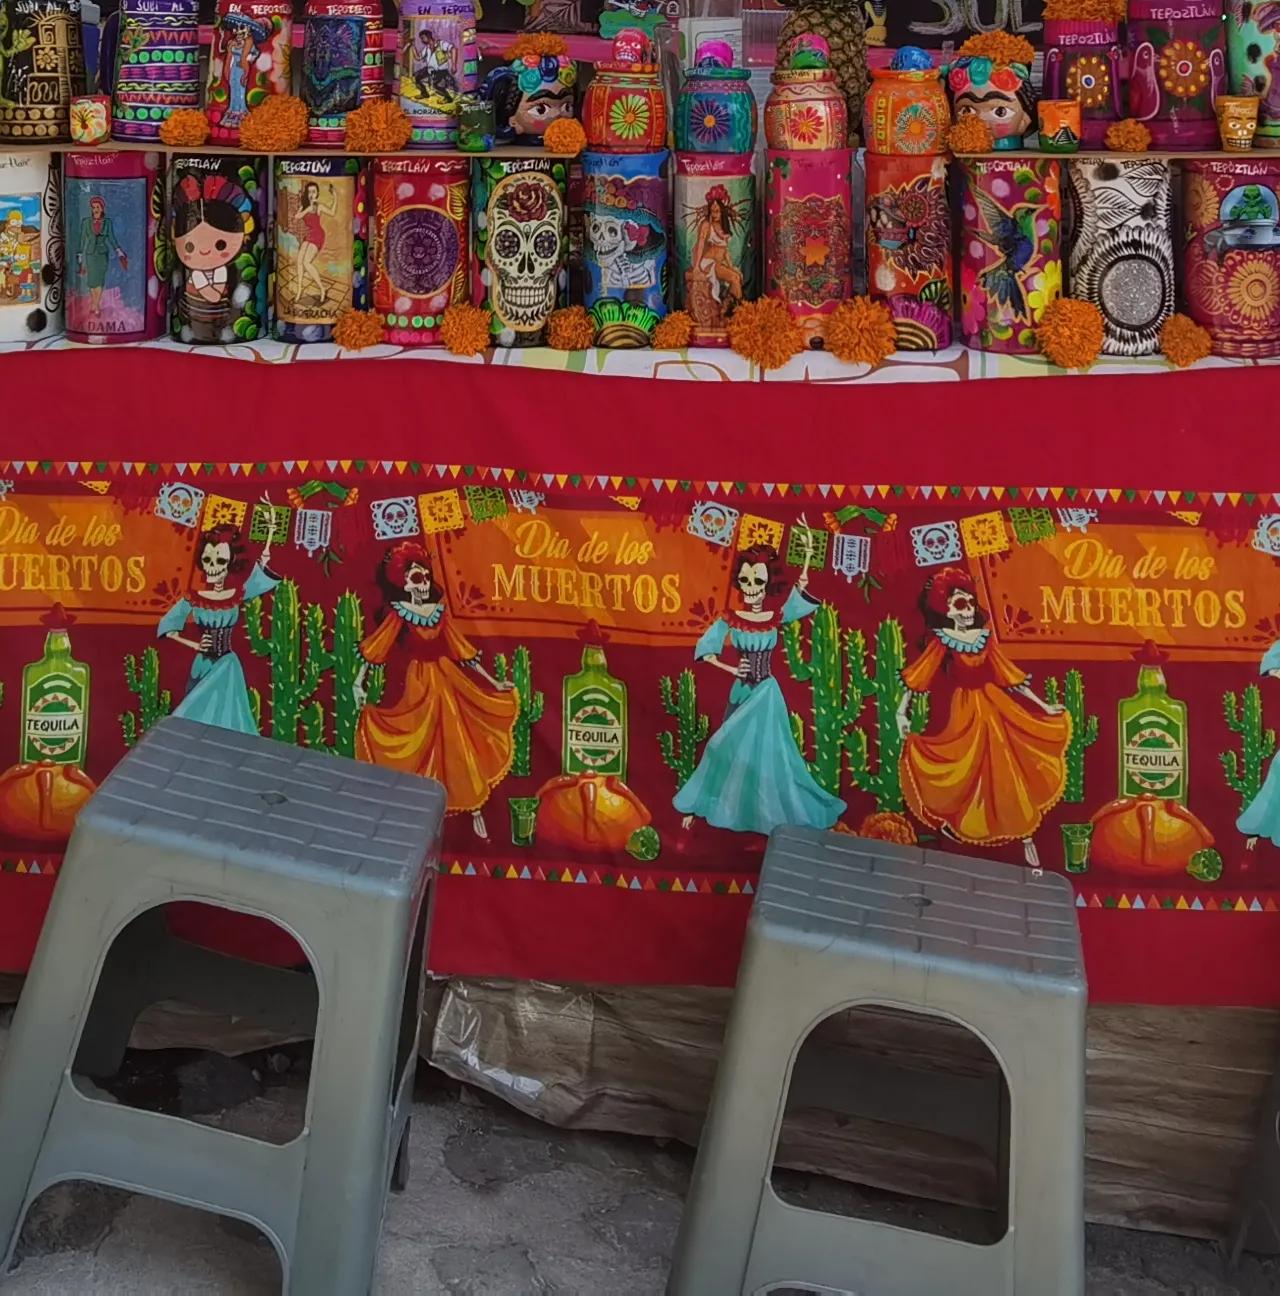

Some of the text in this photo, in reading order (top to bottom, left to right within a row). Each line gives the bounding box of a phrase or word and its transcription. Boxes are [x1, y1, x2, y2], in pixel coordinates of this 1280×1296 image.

[46, 515, 76, 544] de
[82, 515, 121, 548] los
[577, 528, 609, 563] de
[616, 533, 654, 566] los
[1133, 545, 1168, 580] de
[1175, 545, 1215, 581] los
[491, 563, 681, 614] MUERTOS
[1040, 585, 1247, 630] MUERTOS
[26, 717, 80, 732] TEQUILA
[568, 728, 620, 745] TEQUILA
[1125, 752, 1180, 768] TEQUILA
